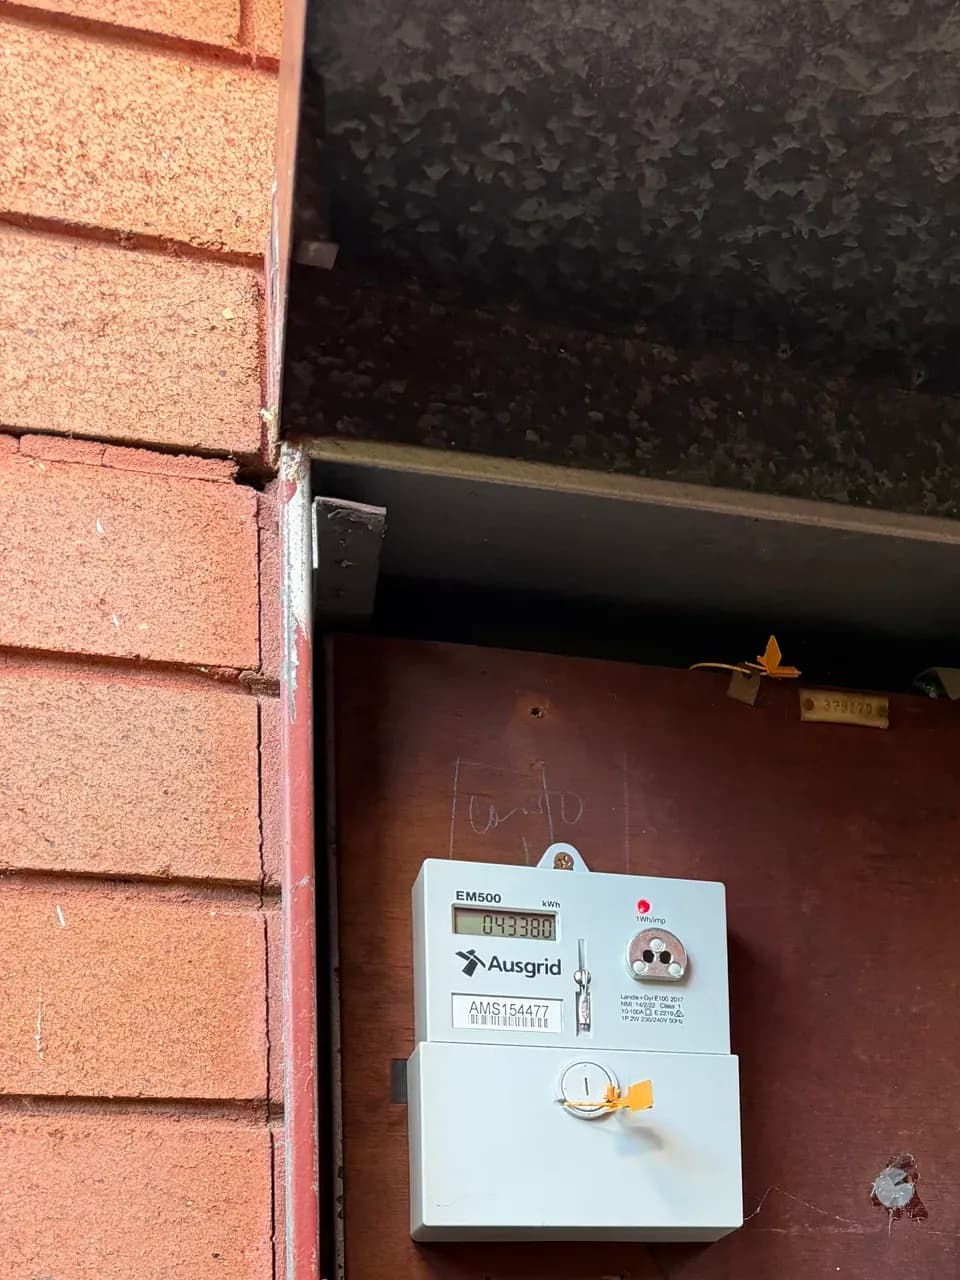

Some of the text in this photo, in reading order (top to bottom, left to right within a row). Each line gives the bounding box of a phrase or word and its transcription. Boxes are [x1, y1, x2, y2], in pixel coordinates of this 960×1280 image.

[456, 890, 502, 904] EM500
[542, 900, 561, 909] kWh
[483, 914, 552, 939] 043380
[488, 955, 562, 979] Ausgrid
[469, 1001, 549, 1018] AMS154477
